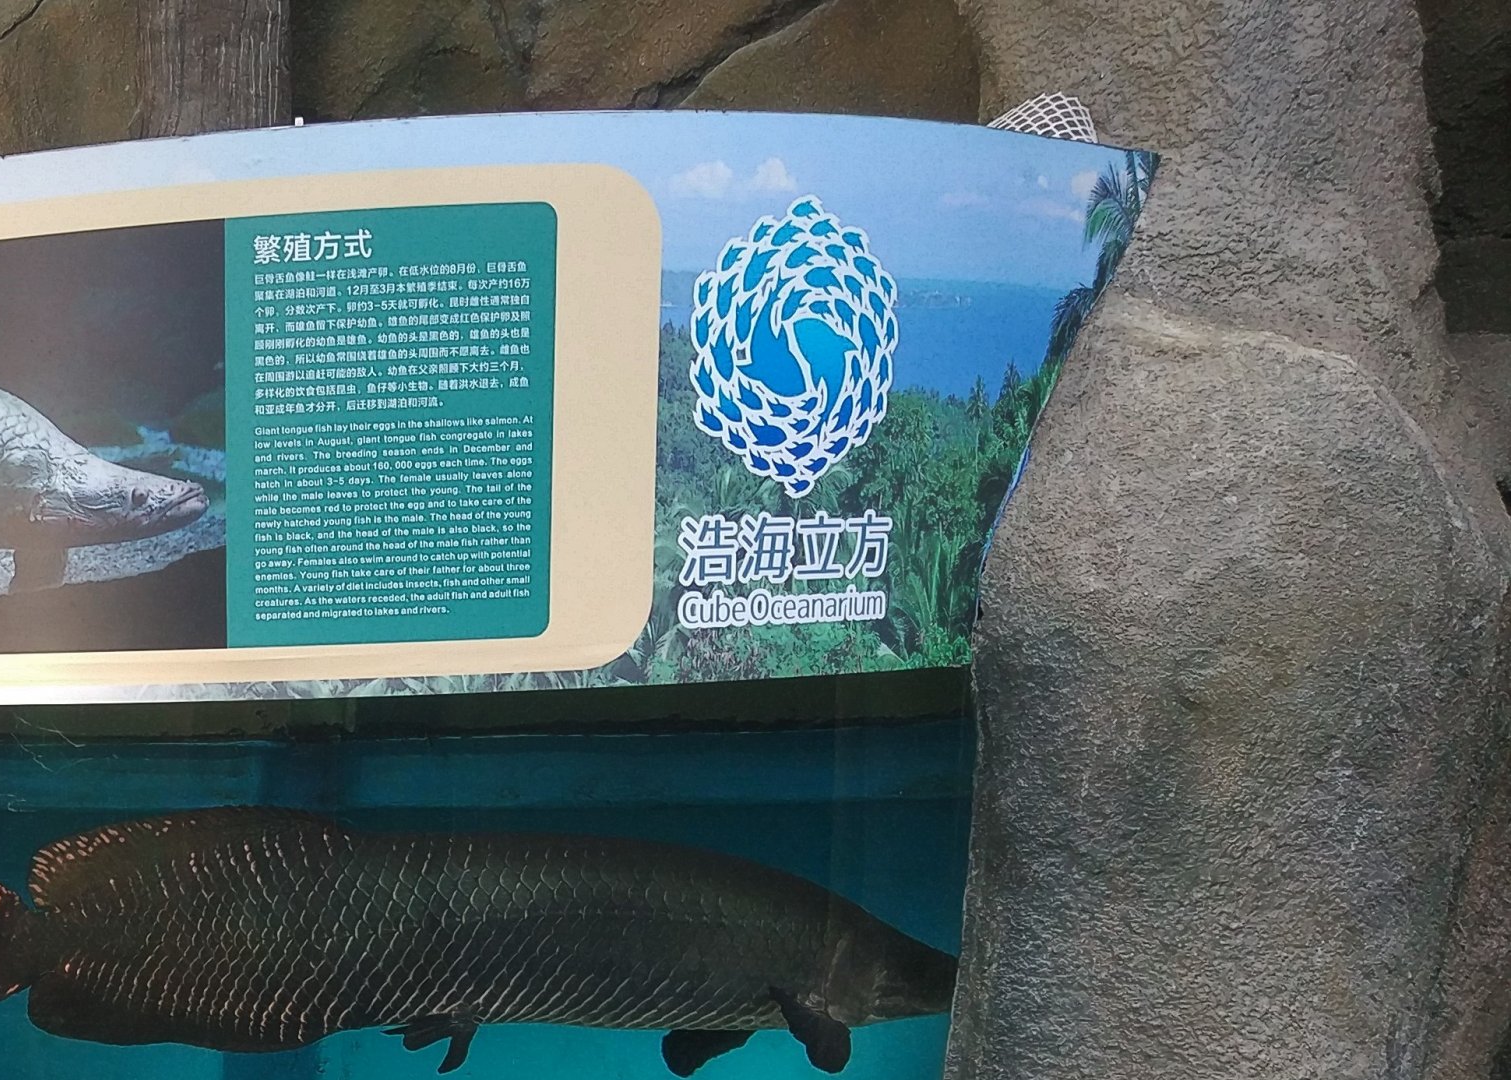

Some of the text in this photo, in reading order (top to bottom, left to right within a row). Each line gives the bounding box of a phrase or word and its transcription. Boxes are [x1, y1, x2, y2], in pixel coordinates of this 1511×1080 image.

[253, 229, 373, 265] 繁殖方式
[254, 414, 533, 437] Giant tongue fish lay their eggs in the shallows like salmon. At
[254, 427, 533, 449] low levels in August, giant tongue fish congregate in lakes
[254, 441, 532, 462] and rivers. The breeding season ends in December and
[254, 455, 532, 476] march. It produces about 160, 000 eggs each time. The eggs
[254, 467, 532, 488] hatch in about 3-5 days. The female usually leaves alone
[254, 481, 532, 501] while the male leaves to protect the young. The tail of the
[254, 494, 532, 514] male becomes red to protect the egg and to take care of the
[679, 512, 890, 585] 浩海立方
[255, 604, 451, 622] separated and migrated to lakes and rivers.
[681, 591, 884, 624] Cube Oceanarium
